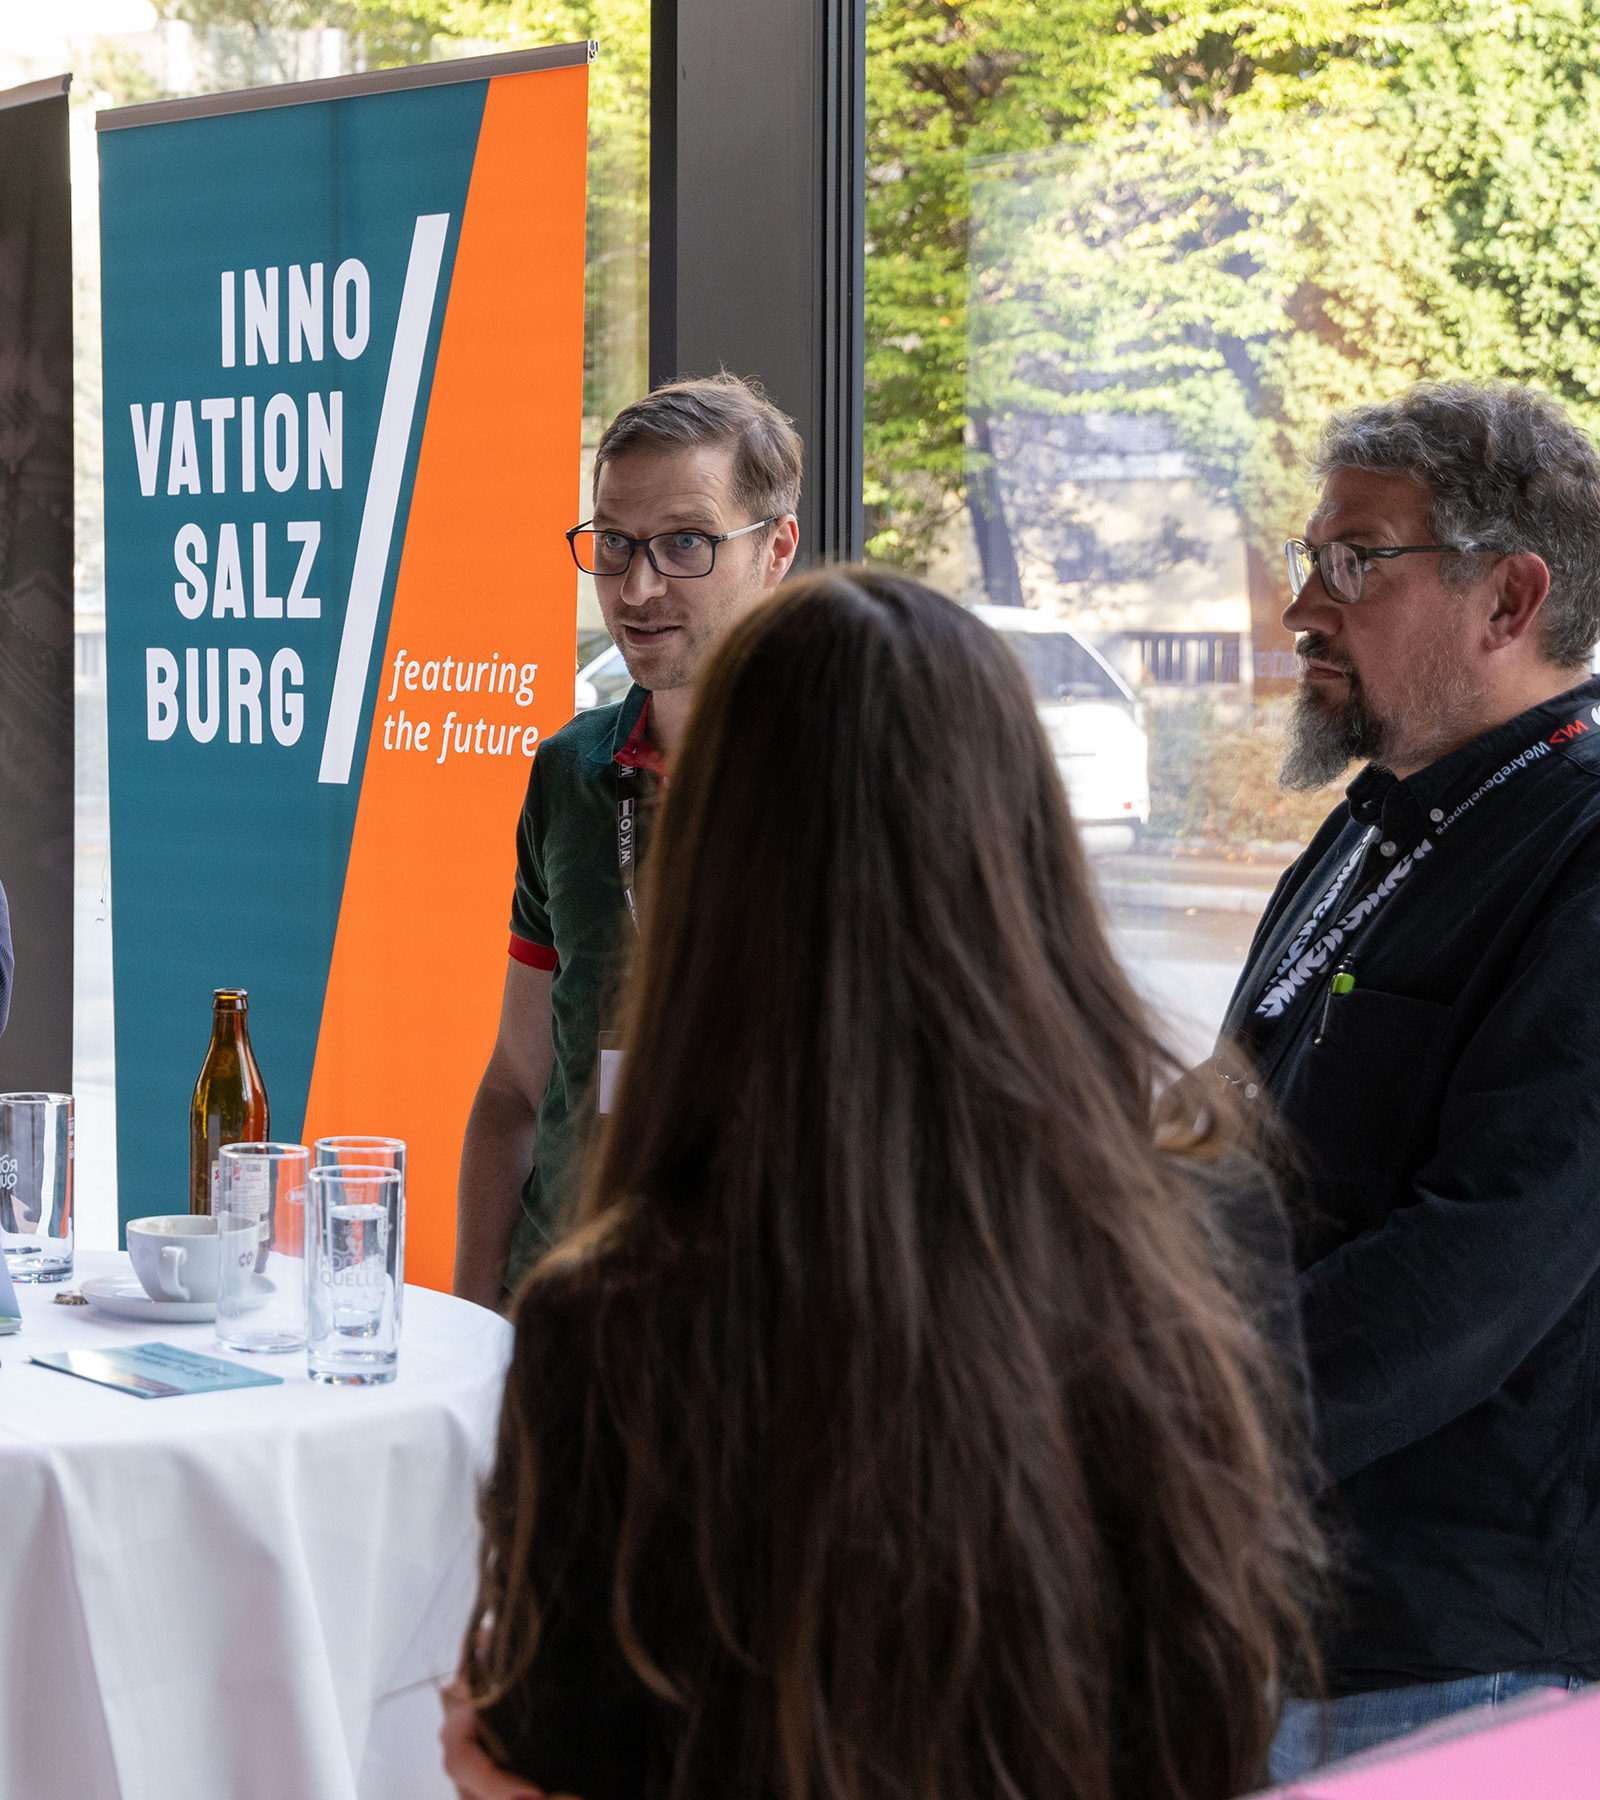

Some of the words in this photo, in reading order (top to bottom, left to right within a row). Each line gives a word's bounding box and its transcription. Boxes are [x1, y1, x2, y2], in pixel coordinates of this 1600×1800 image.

[221, 258, 371, 368] INNO
[129, 390, 343, 497] VATION
[174, 520, 321, 620] SALZ
[145, 647, 305, 747] BURG
[388, 649, 539, 707] featuring
[383, 709, 431, 752] the
[436, 711, 539, 765] future
[1434, 740, 1551, 835] WeAreDevelopers
